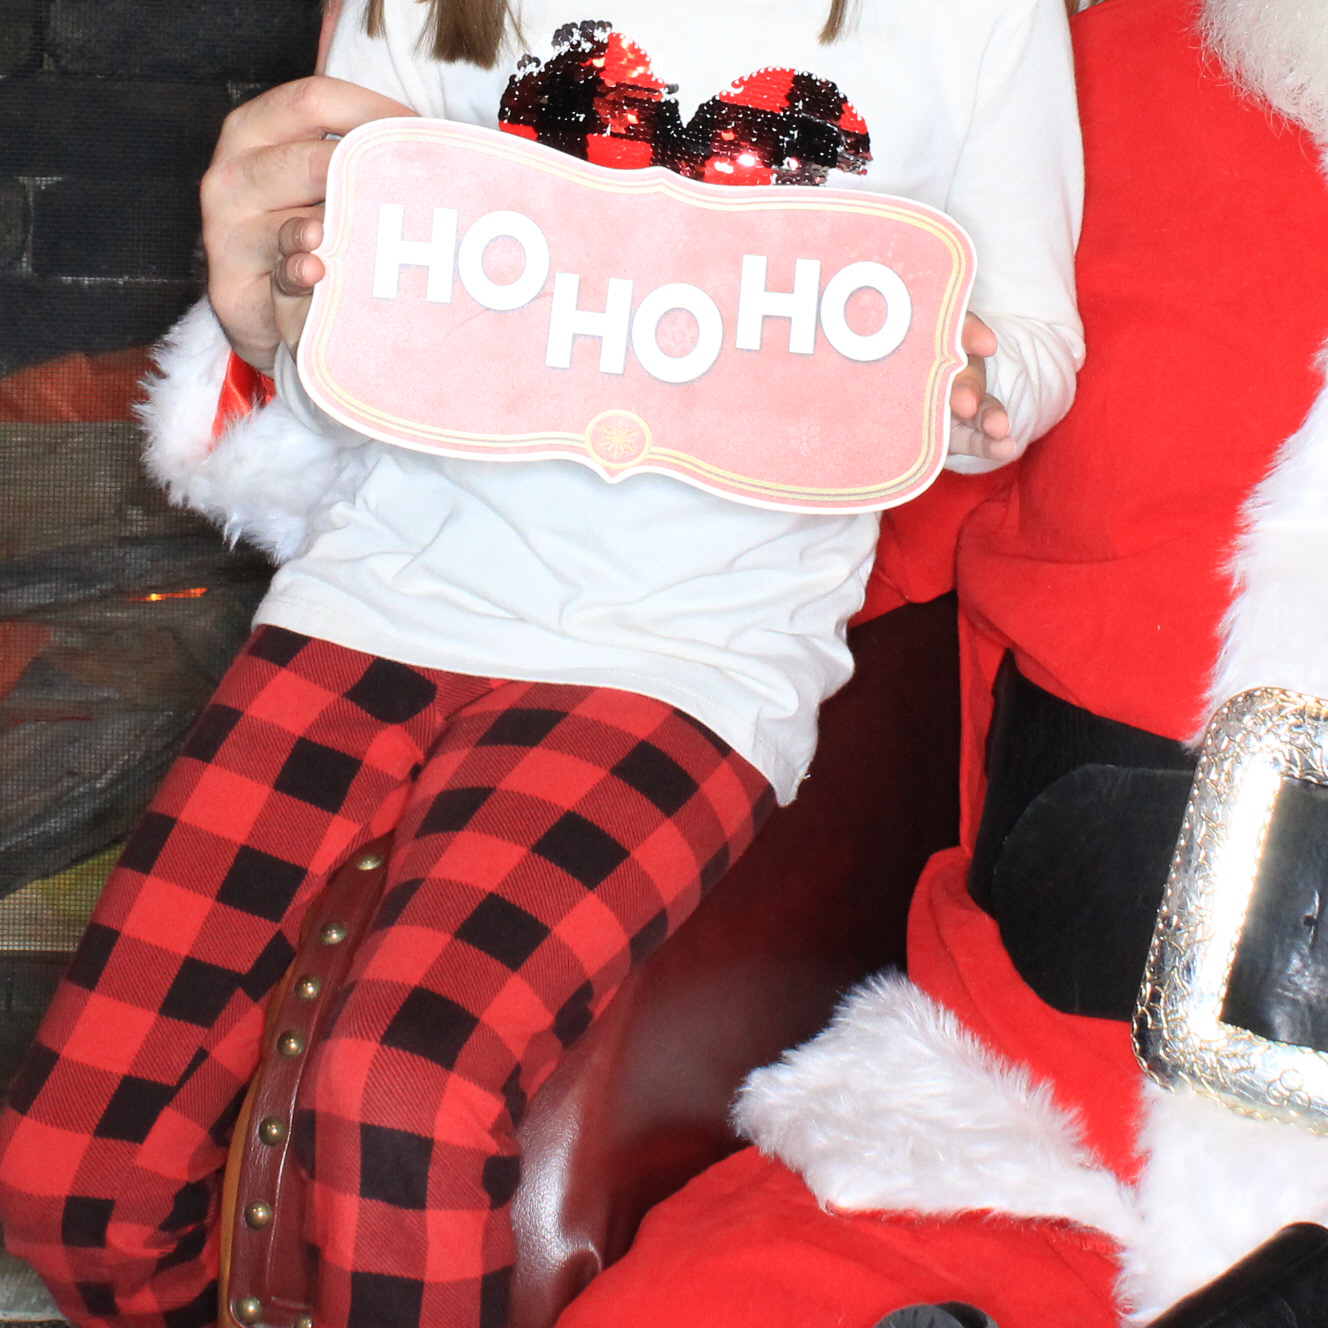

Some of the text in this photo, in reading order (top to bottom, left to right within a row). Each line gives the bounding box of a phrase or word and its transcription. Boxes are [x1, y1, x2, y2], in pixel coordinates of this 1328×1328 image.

[373, 202, 913, 384] HO HO HO
